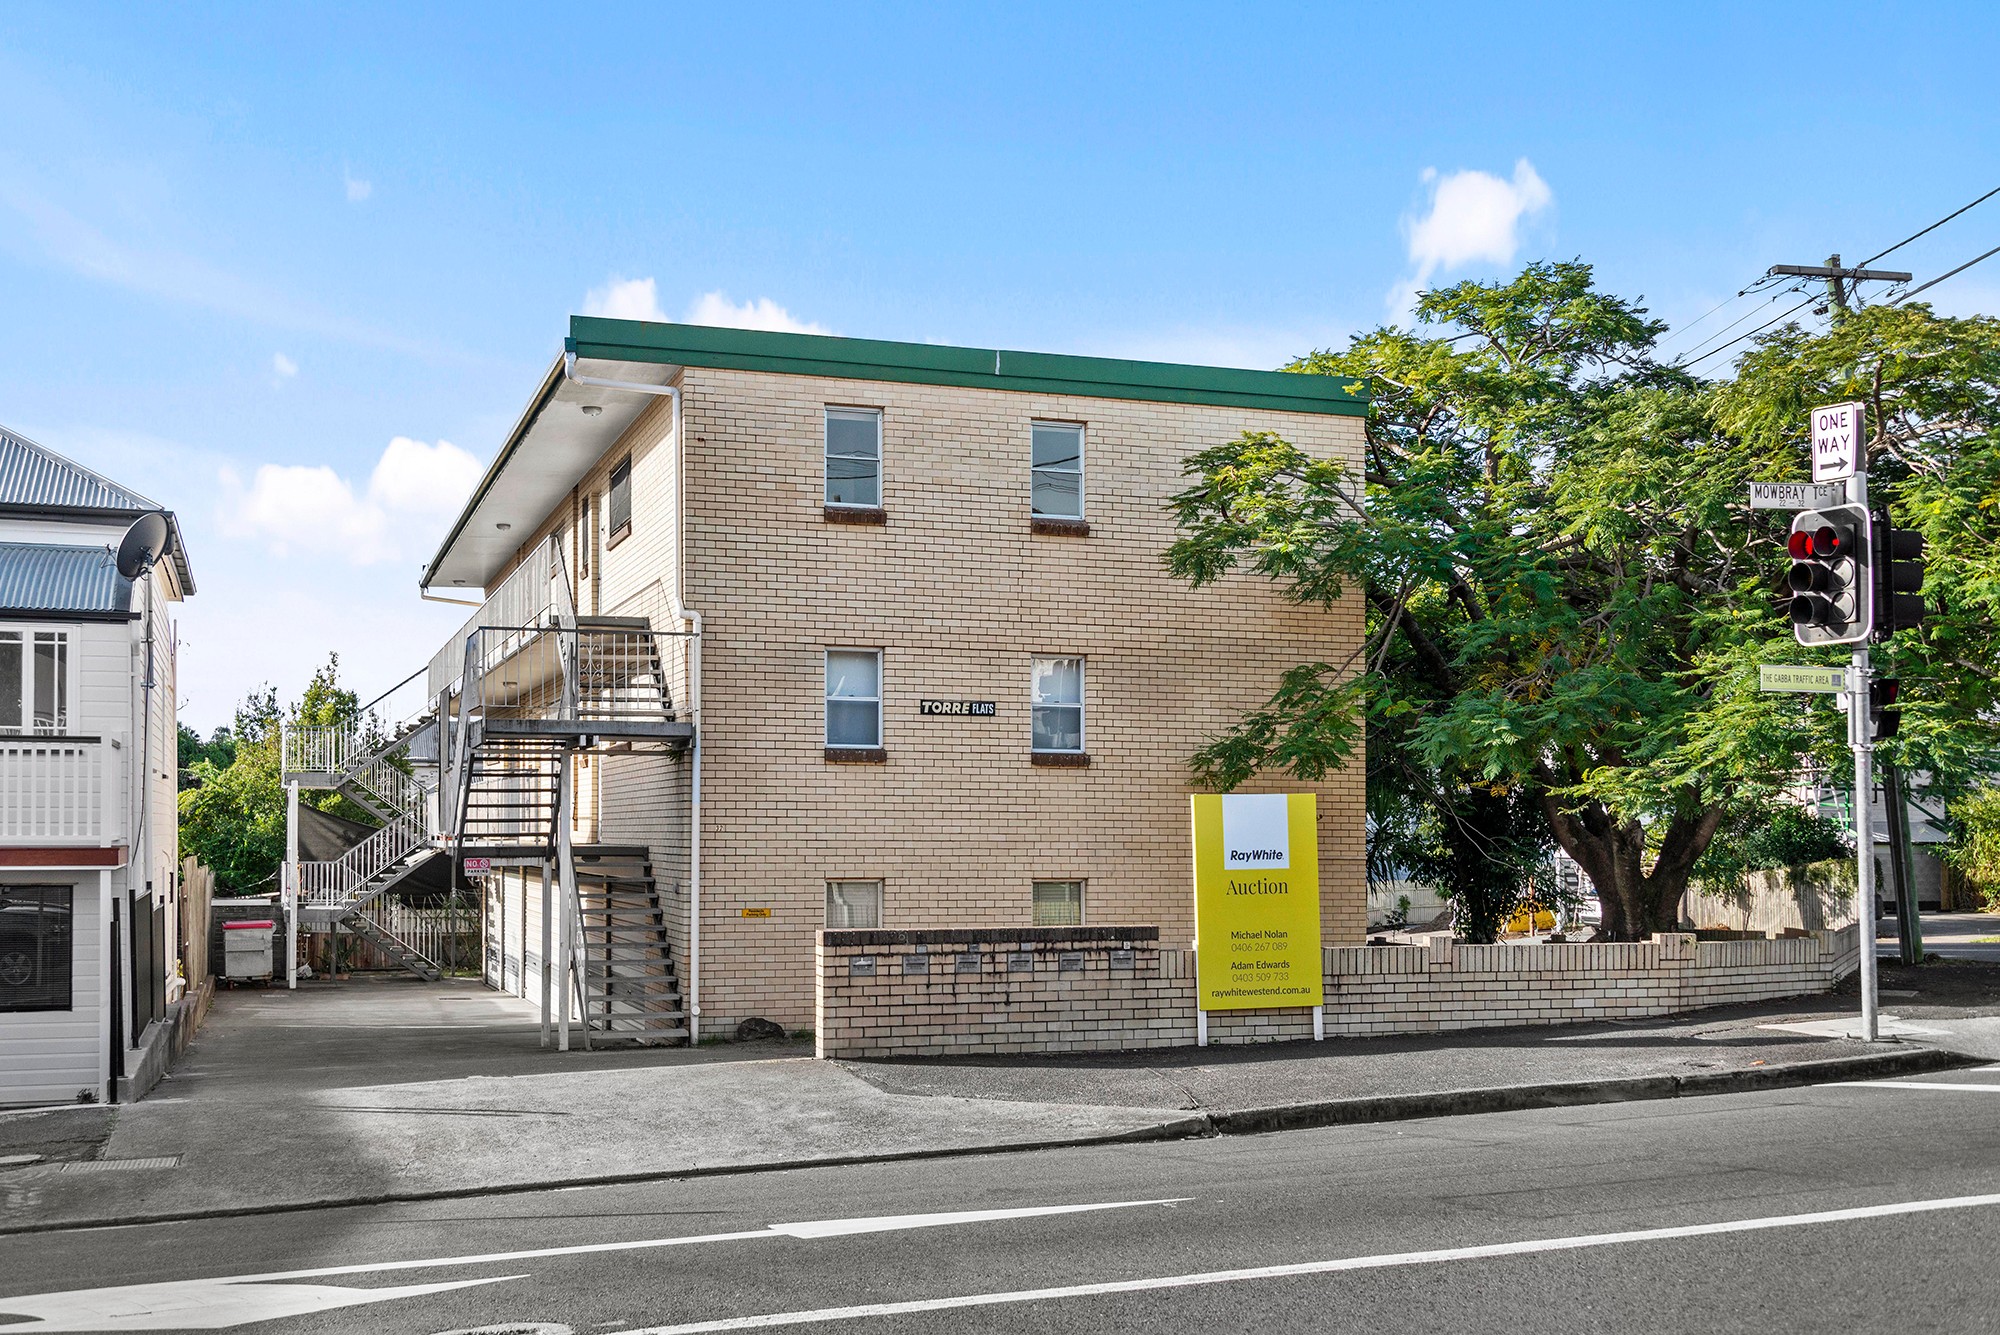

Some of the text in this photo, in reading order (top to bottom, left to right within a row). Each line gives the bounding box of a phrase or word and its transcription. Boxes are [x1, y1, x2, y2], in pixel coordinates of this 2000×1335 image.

[1820, 412, 1848, 431] ONE
[1818, 433, 1850, 455] WAY
[1754, 485, 1828, 500] MOWBRAY TCE
[1763, 673, 1829, 685] THE GABBA TRAFFIC AREA
[922, 701, 994, 714] TORRE FLATS
[1230, 849, 1283, 862] RayWhite
[466, 860, 478, 868] NO
[1226, 877, 1288, 896] Auction
[1231, 930, 1288, 940] Michael Nolan
[1231, 941, 1288, 952] 0406 267 089
[1230, 960, 1290, 970] Adam Edwards
[1232, 971, 1289, 982] 0403 509 733
[1211, 985, 1311, 999] raywhitewestend.com.au
